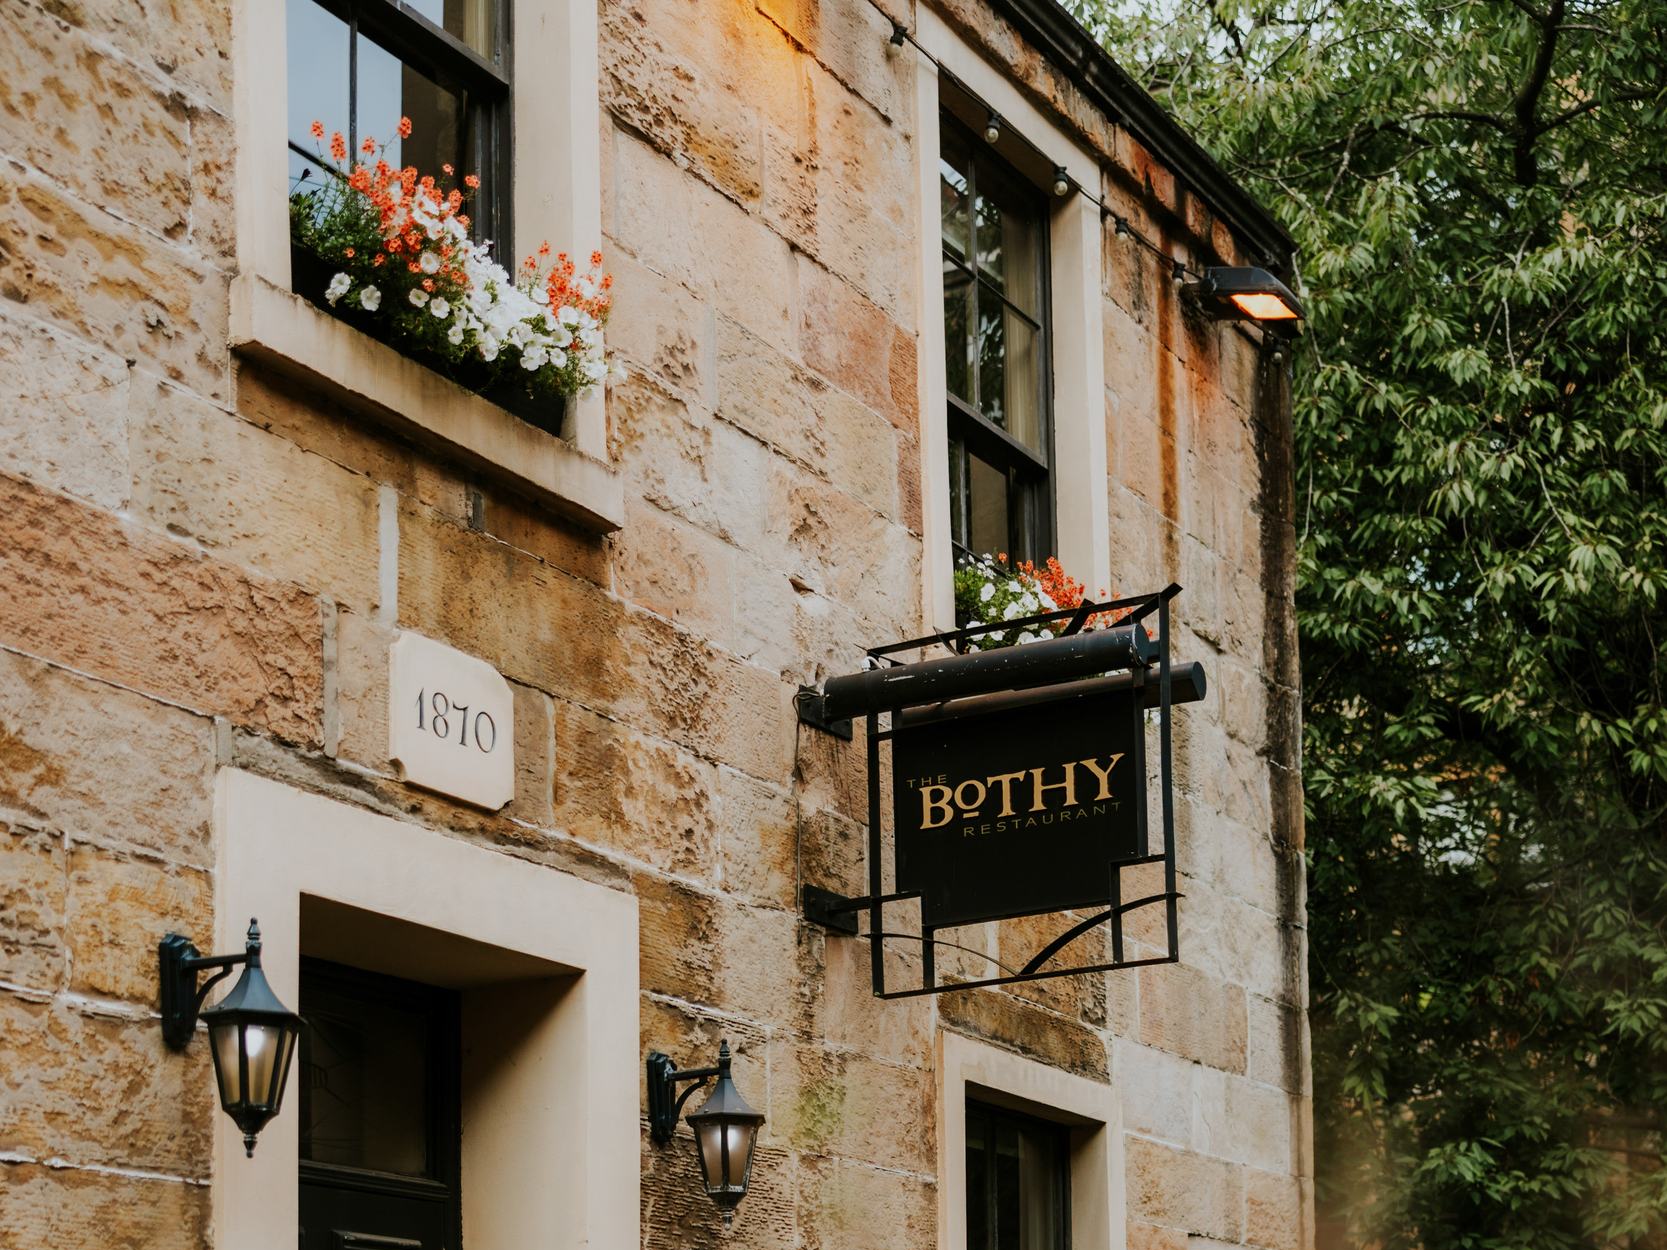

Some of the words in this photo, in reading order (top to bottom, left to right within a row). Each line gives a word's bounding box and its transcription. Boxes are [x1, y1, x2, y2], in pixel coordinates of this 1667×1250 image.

[415, 687, 496, 754] 1870
[906, 774, 948, 789] THE
[963, 801, 1122, 838] RESTAURANT
